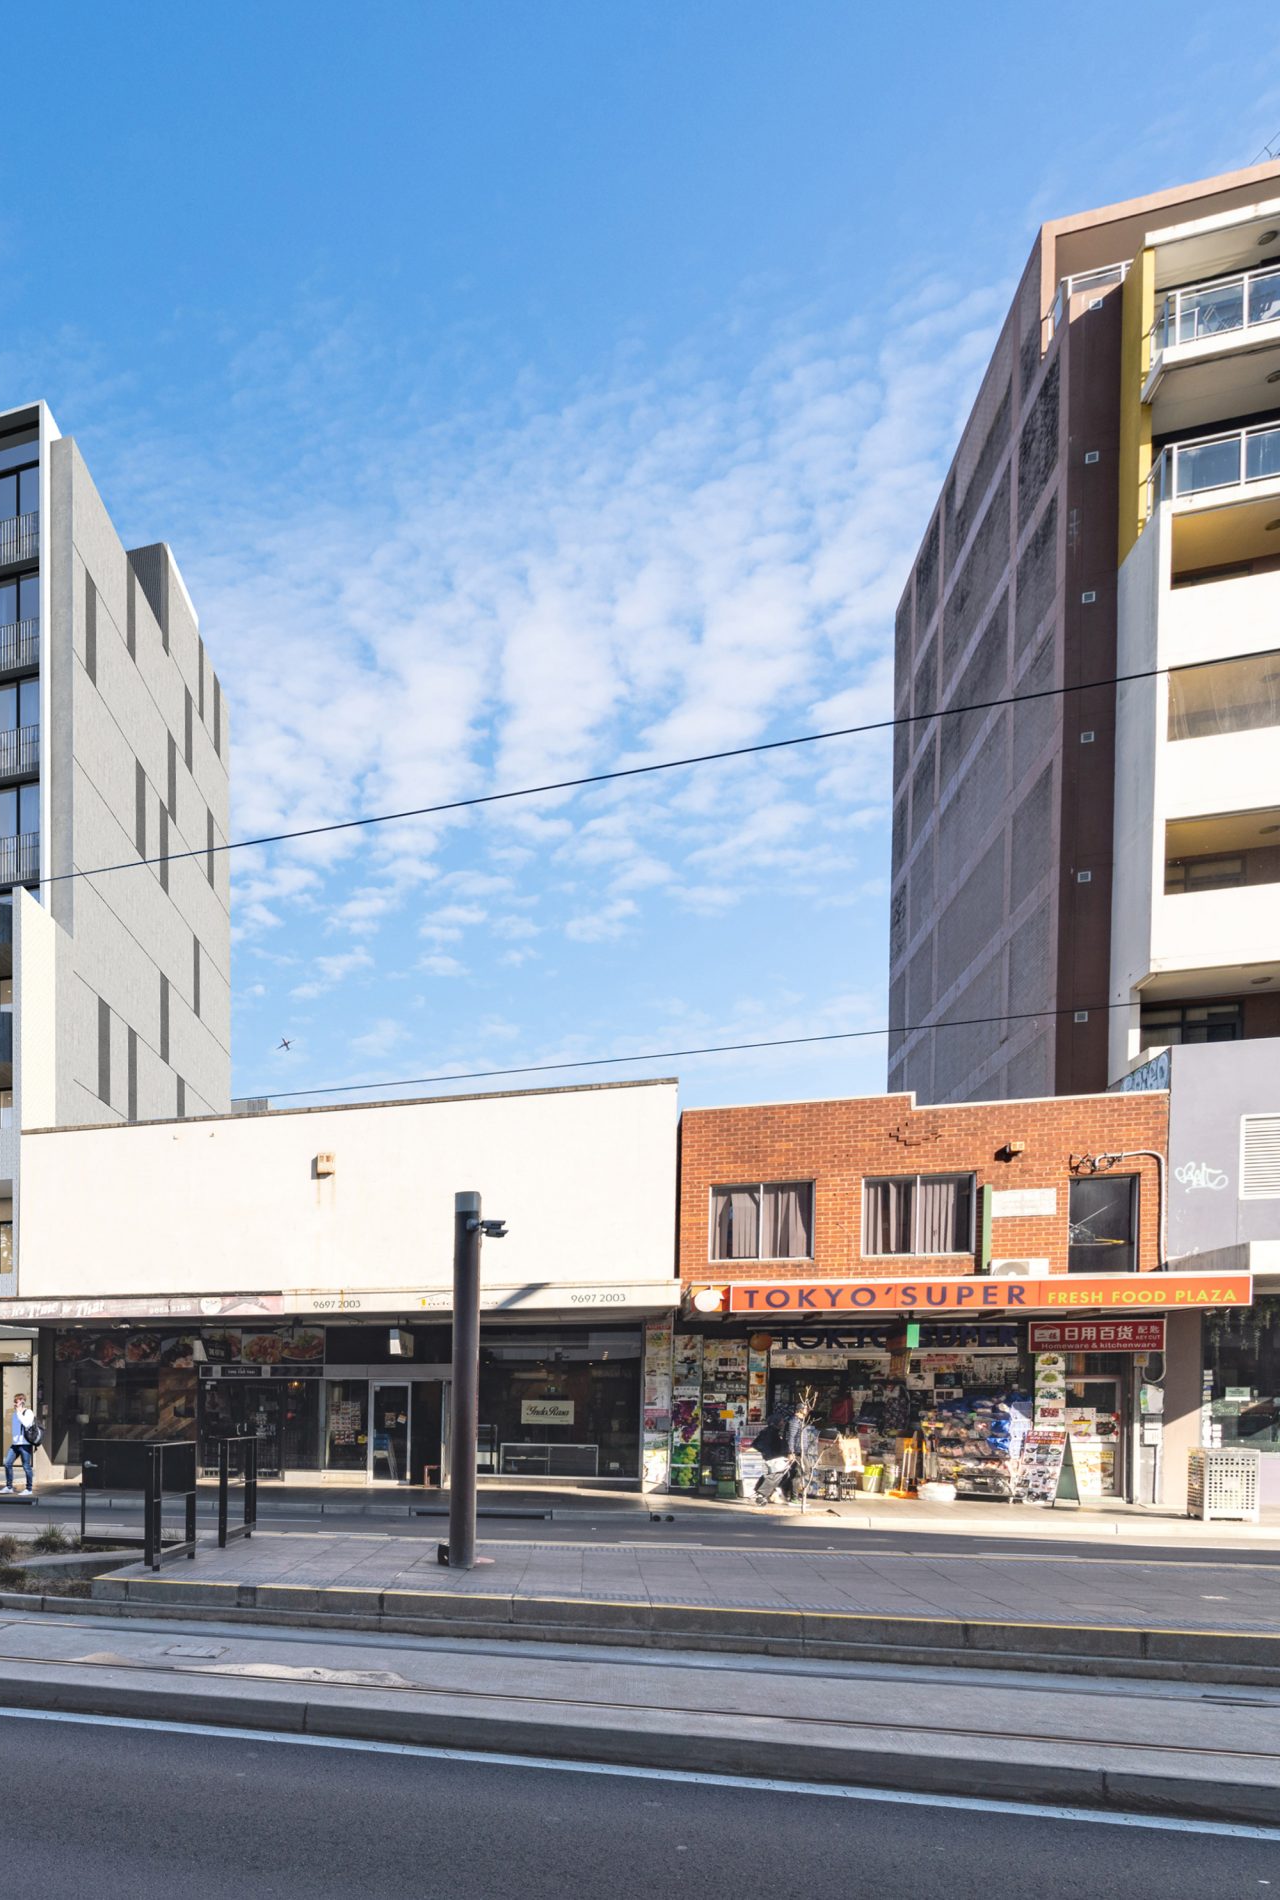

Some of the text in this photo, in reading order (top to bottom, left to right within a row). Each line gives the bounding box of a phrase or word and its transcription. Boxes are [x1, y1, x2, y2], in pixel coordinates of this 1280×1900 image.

[570, 1293, 626, 1304] 9697 2003
[1047, 1289, 1237, 1304] FRESH FOOD PLAZA
[312, 1299, 361, 1309] 9697 2003
[1064, 1325, 1134, 1341] 日用百货
[1040, 1342, 1090, 1350] Homeware
[1099, 1341, 1158, 1349] kitchenware
